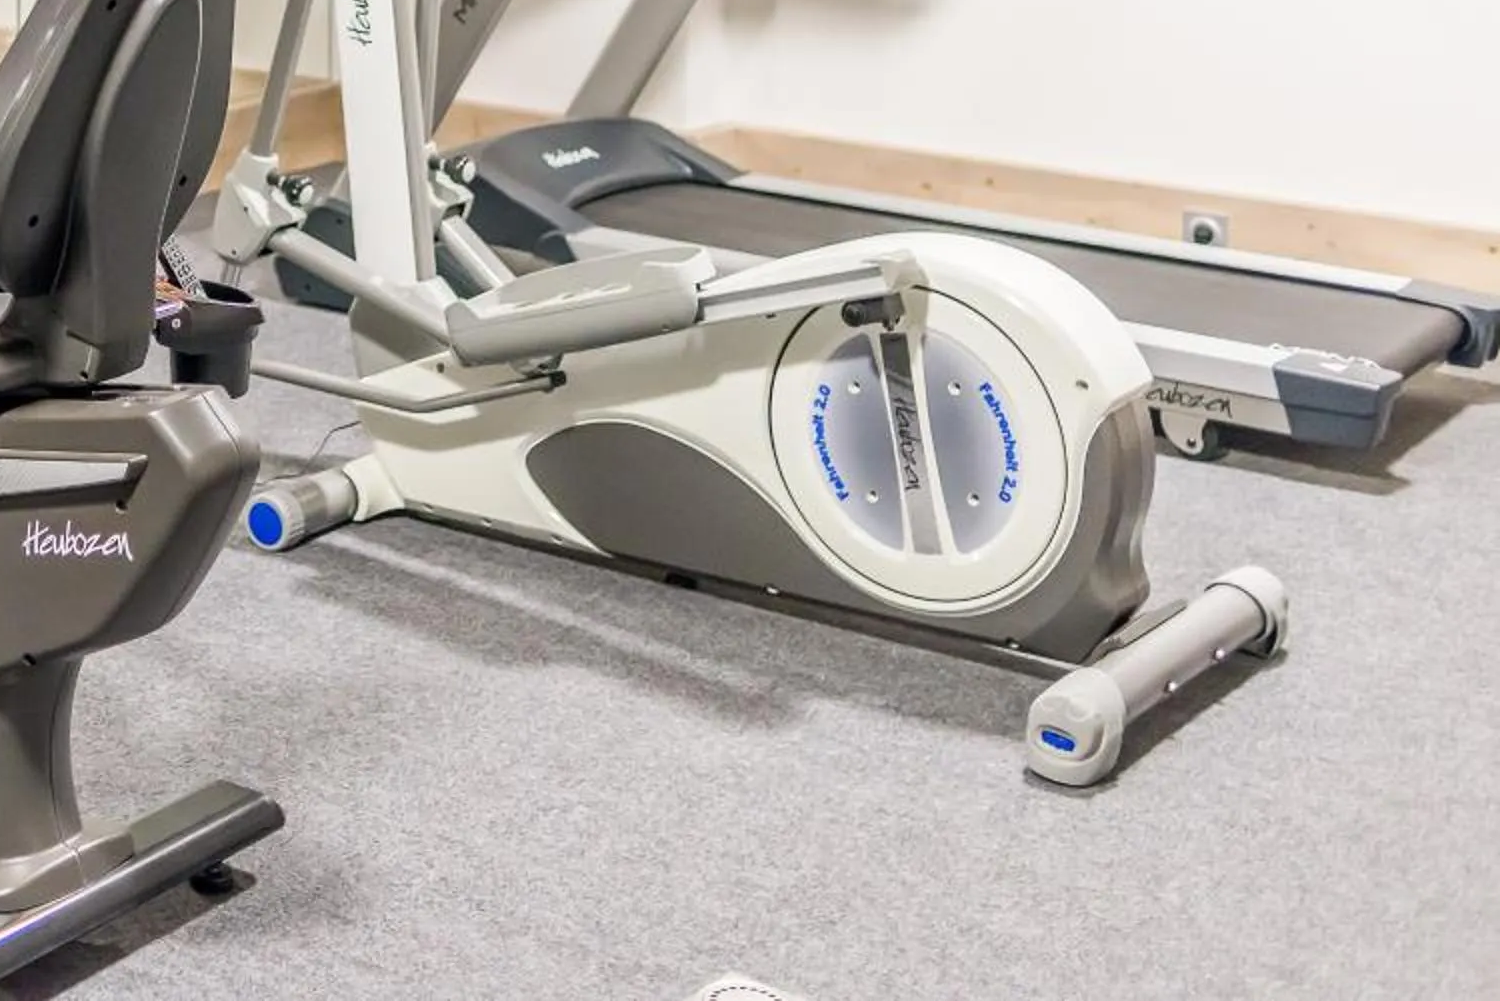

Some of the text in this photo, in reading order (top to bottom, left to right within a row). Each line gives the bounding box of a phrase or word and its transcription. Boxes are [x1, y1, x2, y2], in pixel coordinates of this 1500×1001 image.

[811, 414, 850, 501] Fahrenheit
[979, 382, 1019, 472] Fahrenheit
[21, 519, 135, 562] Heubozen
